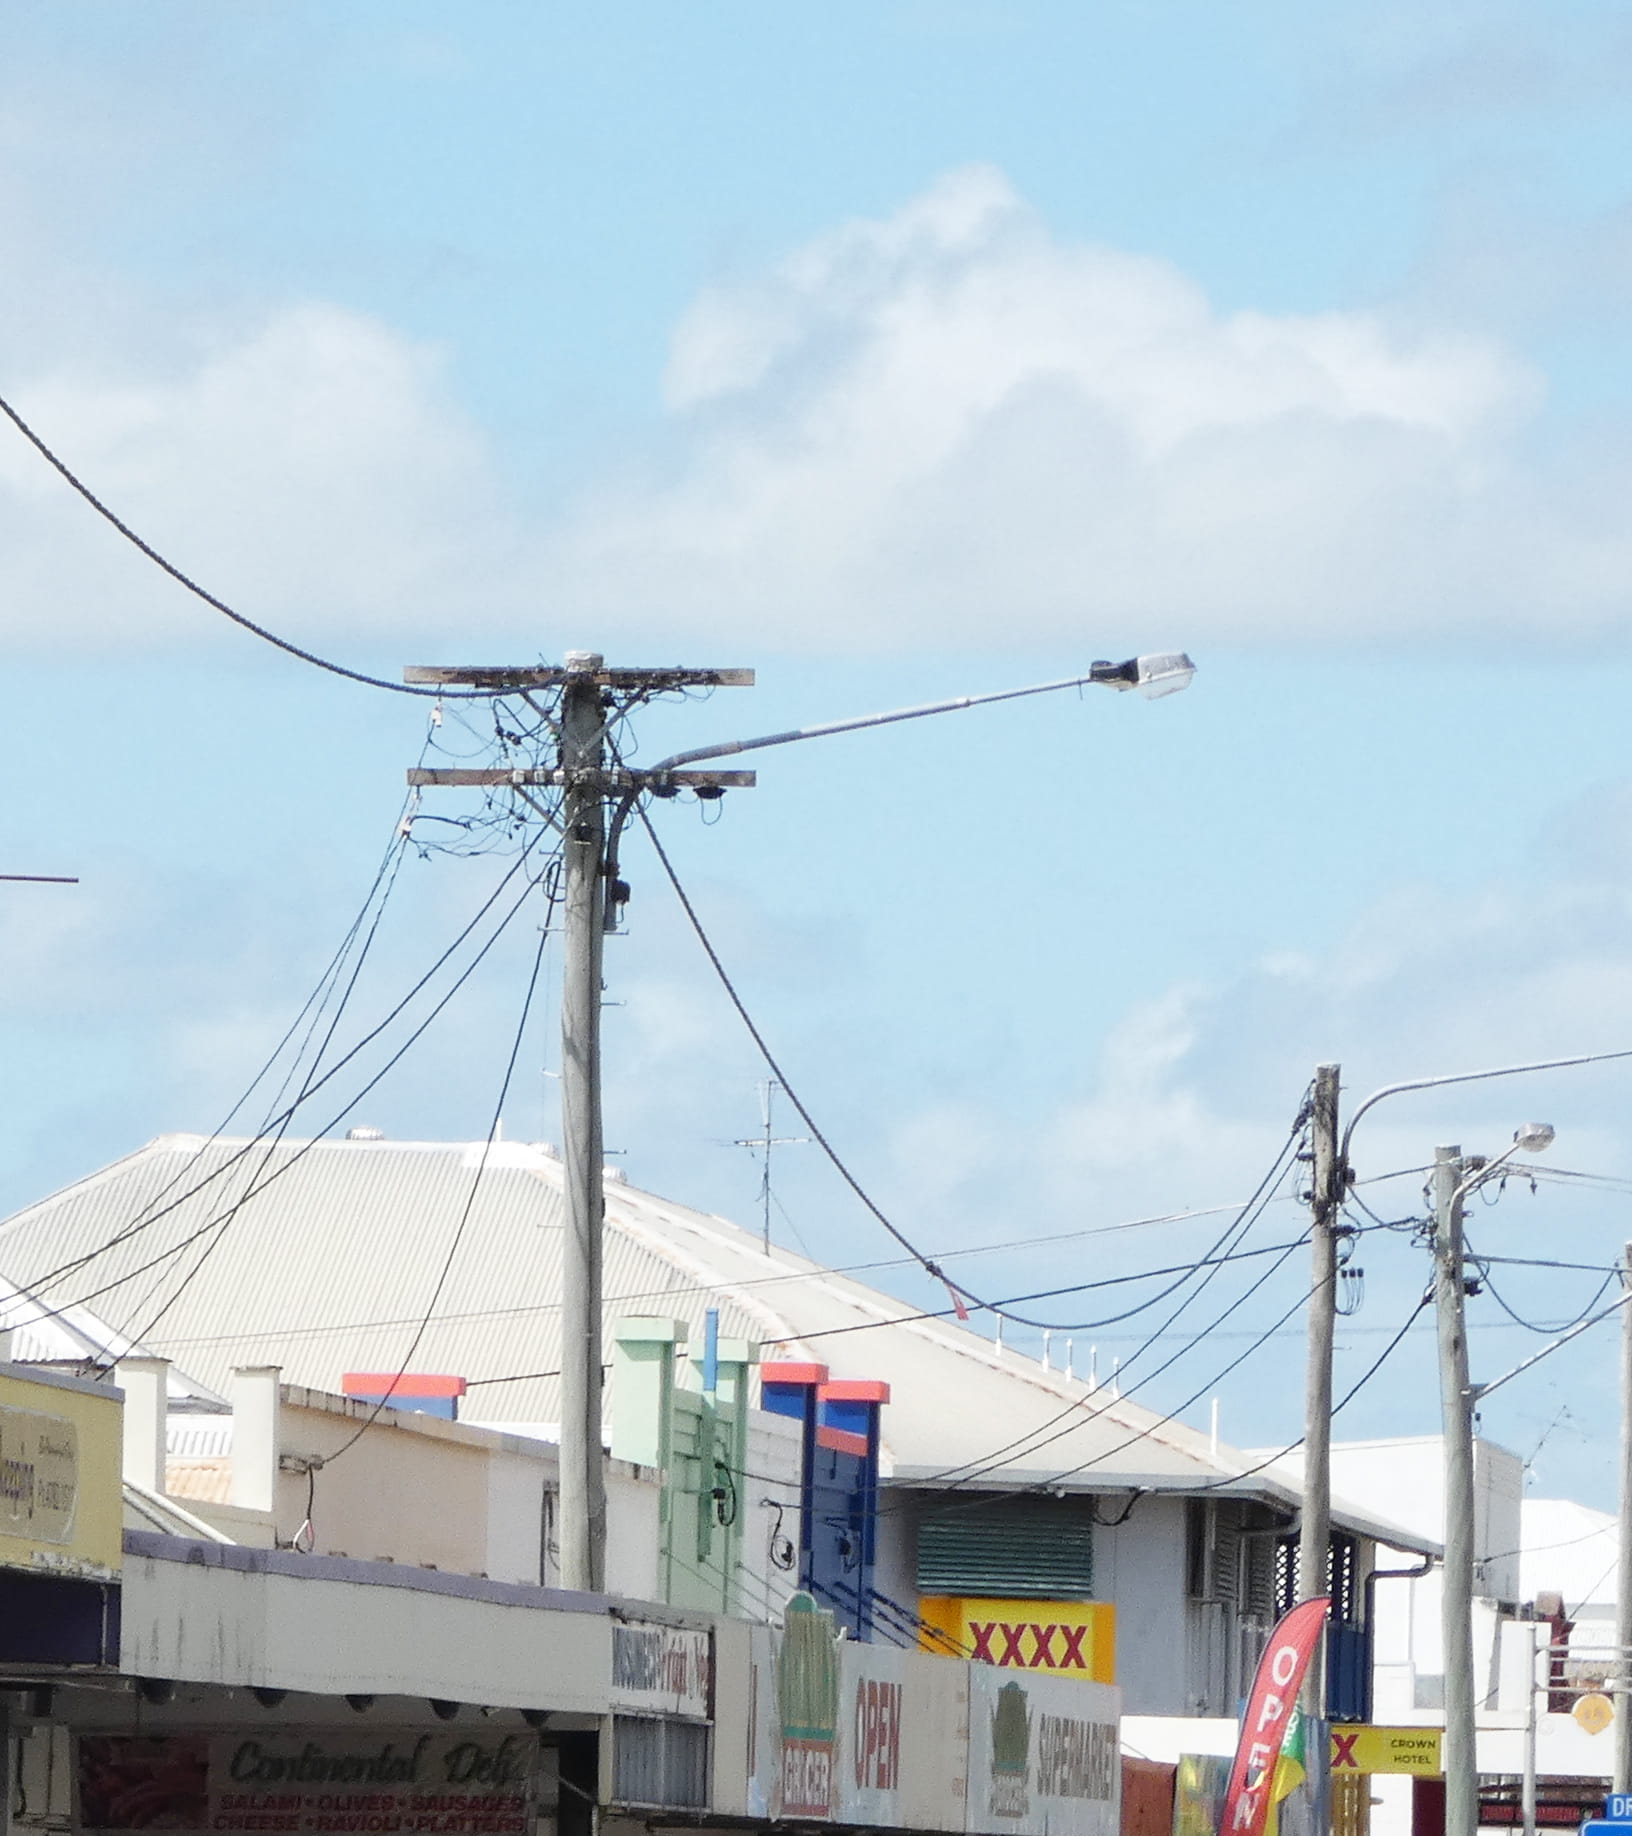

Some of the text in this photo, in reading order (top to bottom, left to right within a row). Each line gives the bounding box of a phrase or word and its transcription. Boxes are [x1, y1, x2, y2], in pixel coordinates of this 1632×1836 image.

[968, 1622, 1088, 1668] XXXX
[854, 1674, 903, 1790] OPEN
[1232, 1646, 1299, 1832] OPEN
[1391, 1739, 1436, 1749] CROWN
[231, 1733, 432, 1784] Continental
[1394, 1755, 1432, 1764] HOTEL
[220, 1794, 524, 1811] SALAMI OLIVES SAUSAGES
[213, 1815, 525, 1832] CHEESE RAVIOLI PLATTERS
